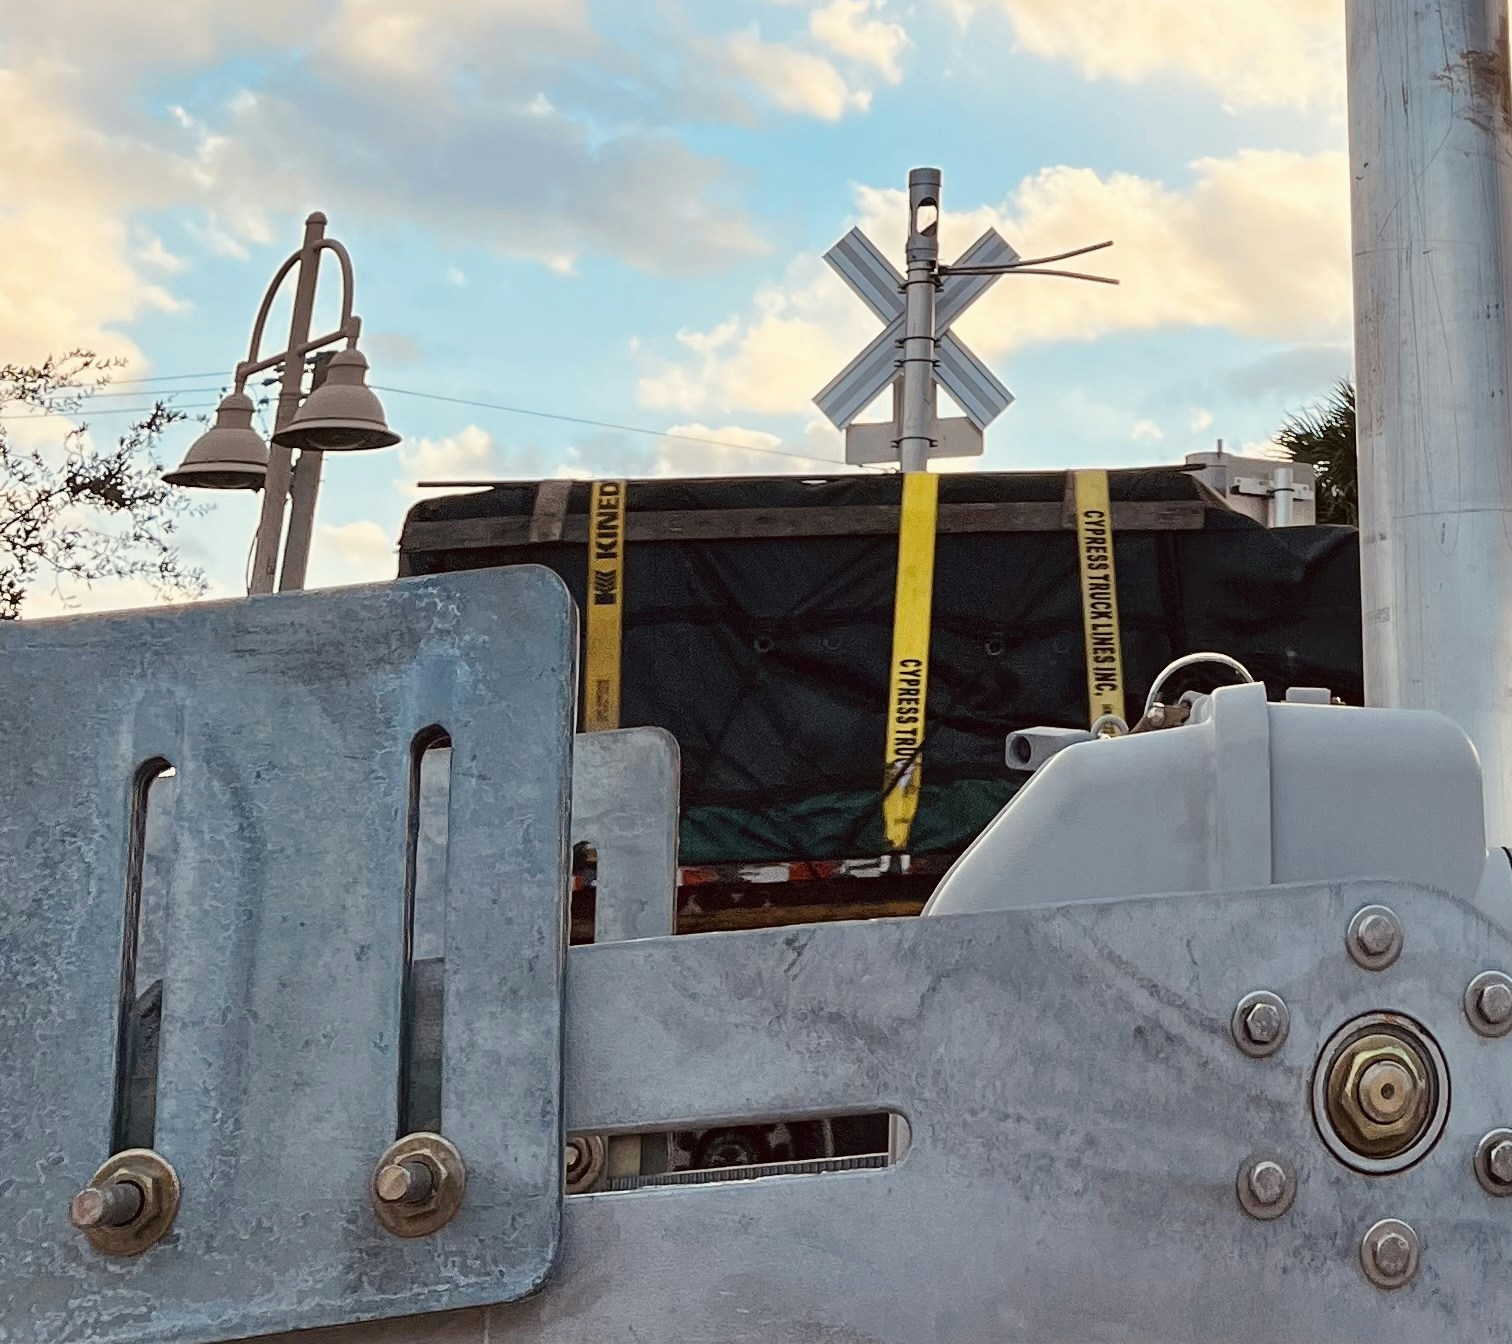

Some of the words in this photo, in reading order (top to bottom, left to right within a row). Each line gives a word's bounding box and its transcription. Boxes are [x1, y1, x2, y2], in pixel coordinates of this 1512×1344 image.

[1084, 510, 1110, 571] CYPRESS
[1088, 574, 1113, 619] TRUCK
[1091, 623, 1115, 668] LINES
[896, 659, 922, 724] CYPRESS
